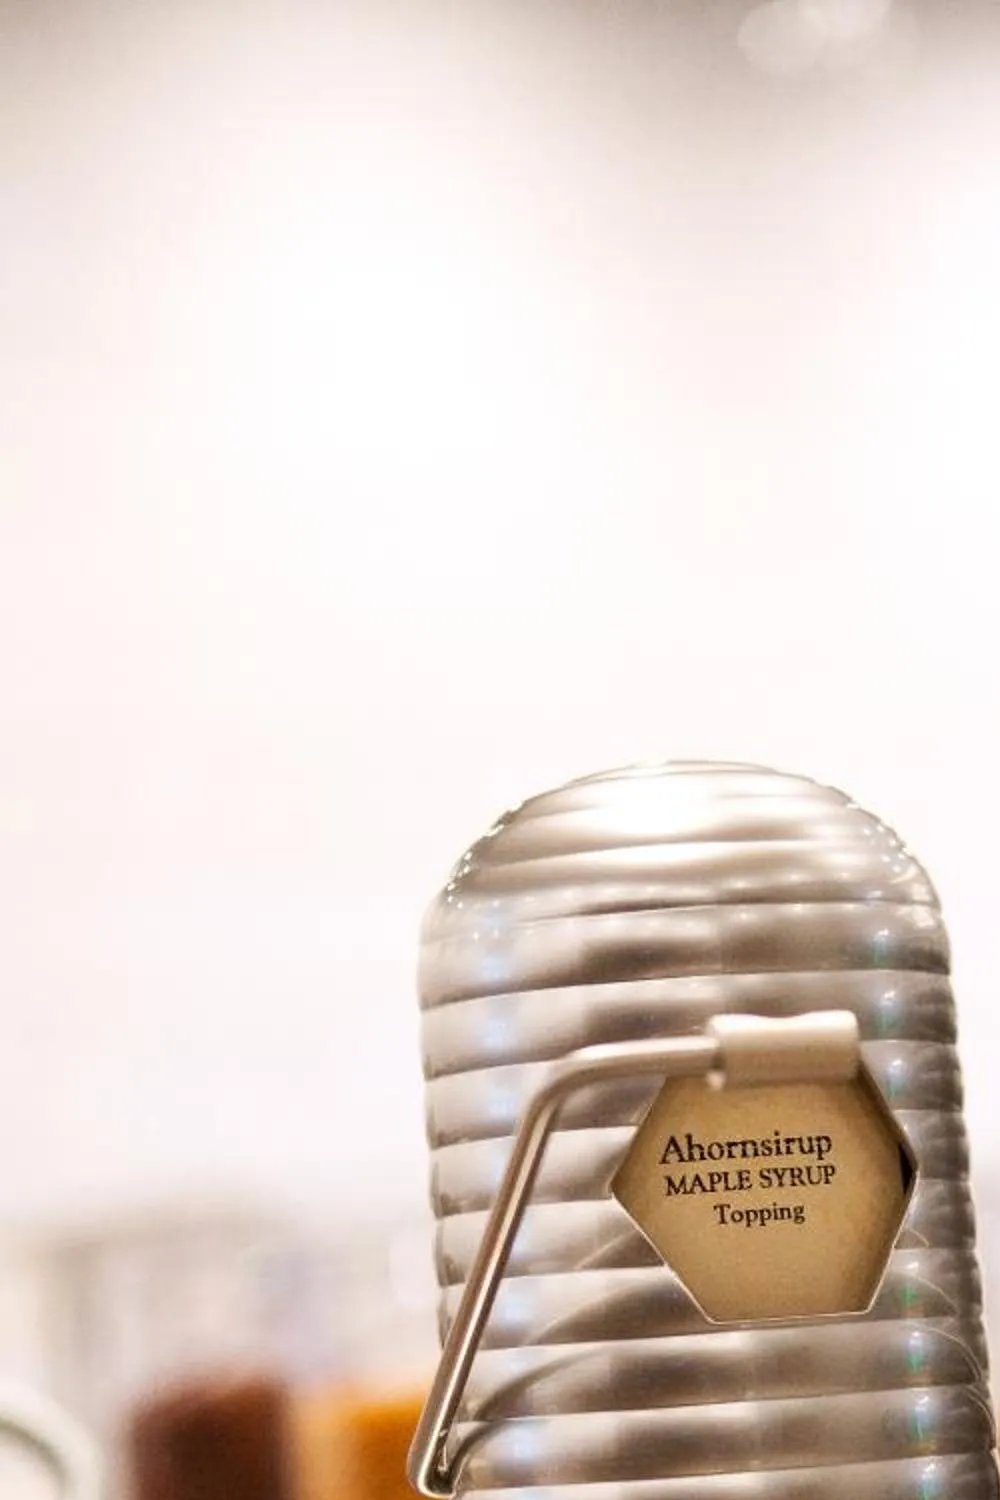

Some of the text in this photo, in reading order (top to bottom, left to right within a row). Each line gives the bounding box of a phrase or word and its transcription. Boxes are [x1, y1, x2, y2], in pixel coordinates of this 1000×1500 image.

[659, 1131, 833, 1164] Ahornsirup
[664, 1164, 836, 1197] MAPLE SYRUP
[714, 1202, 806, 1227] Topping
